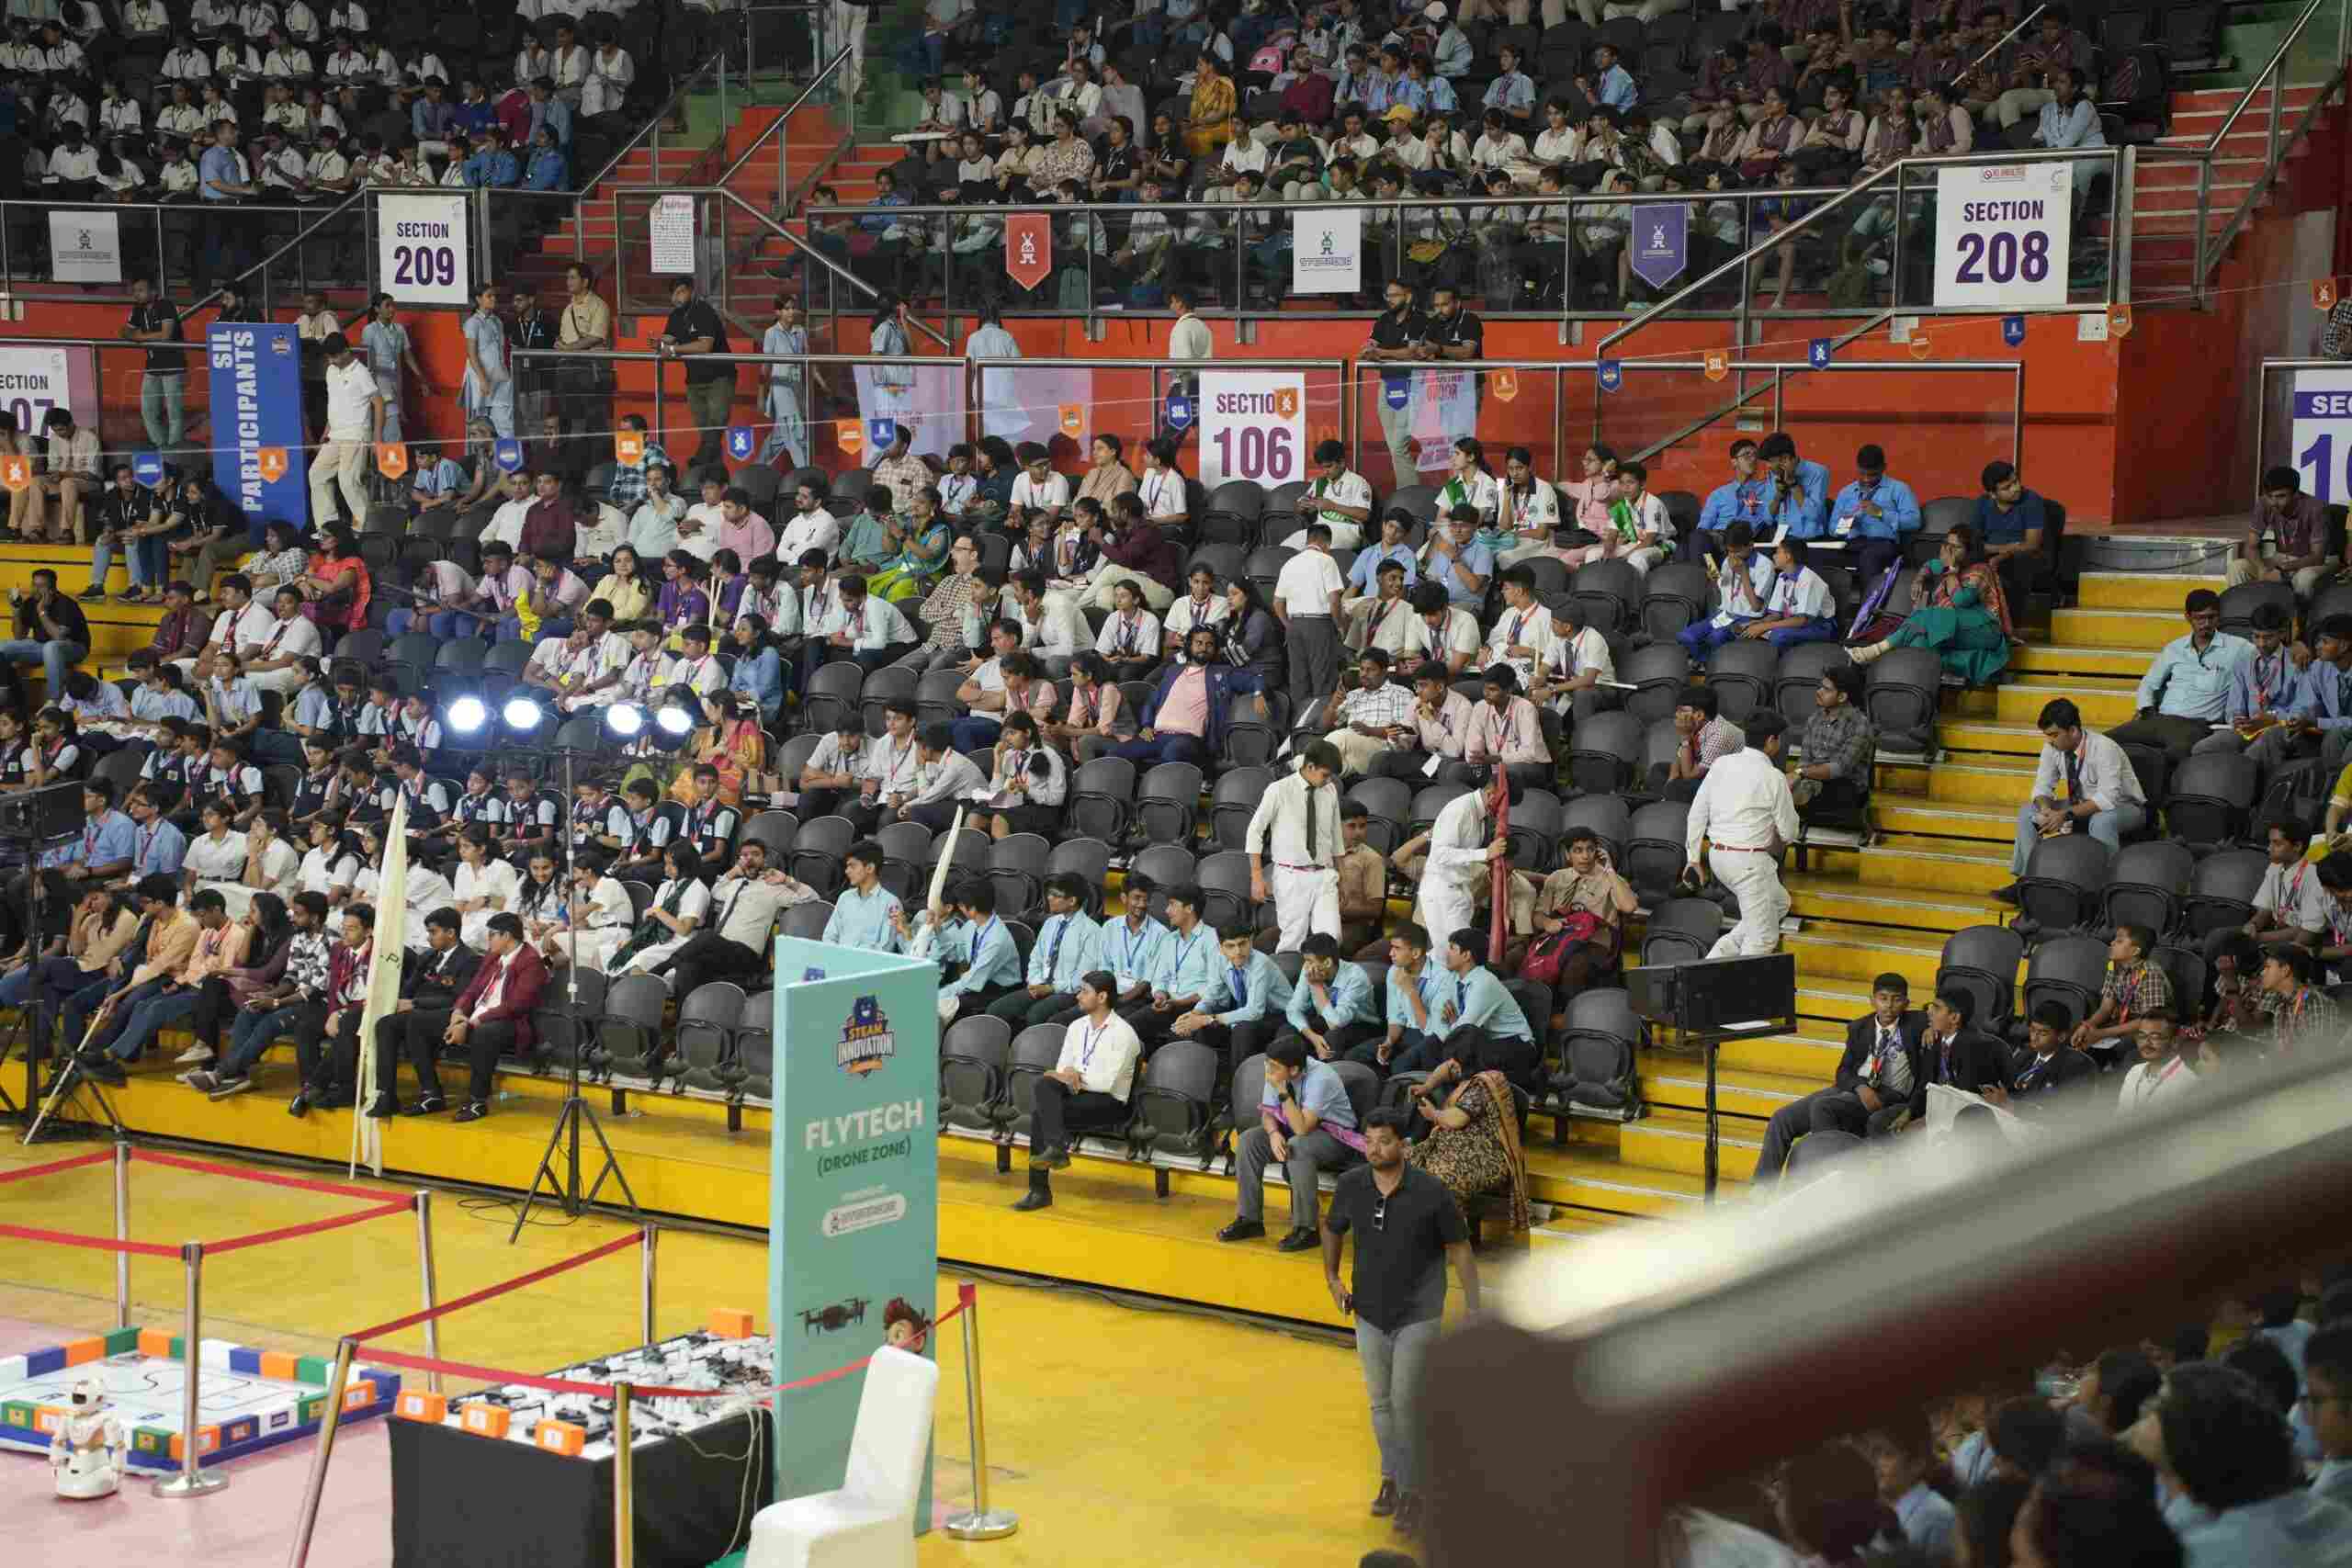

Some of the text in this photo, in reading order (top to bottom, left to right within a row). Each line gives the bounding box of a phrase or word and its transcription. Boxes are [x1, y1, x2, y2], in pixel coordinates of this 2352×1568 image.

[1963, 199, 2044, 222] SECTION
[396, 222, 449, 238] SECTION
[394, 245, 455, 287] 209
[1955, 231, 2049, 284] 208
[212, 331, 232, 368] SIL
[0, 375, 49, 390] ECTION
[0, 398, 54, 437] 07
[233, 331, 263, 511] PARTICIPANTS
[1216, 393, 1277, 414] SECTIO
[2312, 395, 2352, 415] SE
[1214, 426, 1293, 479] 106
[838, 1032, 893, 1066] INNOVATION
[805, 1099, 923, 1150] FLYTECH
[817, 1134, 911, 1177] (DRONE ZONE)
